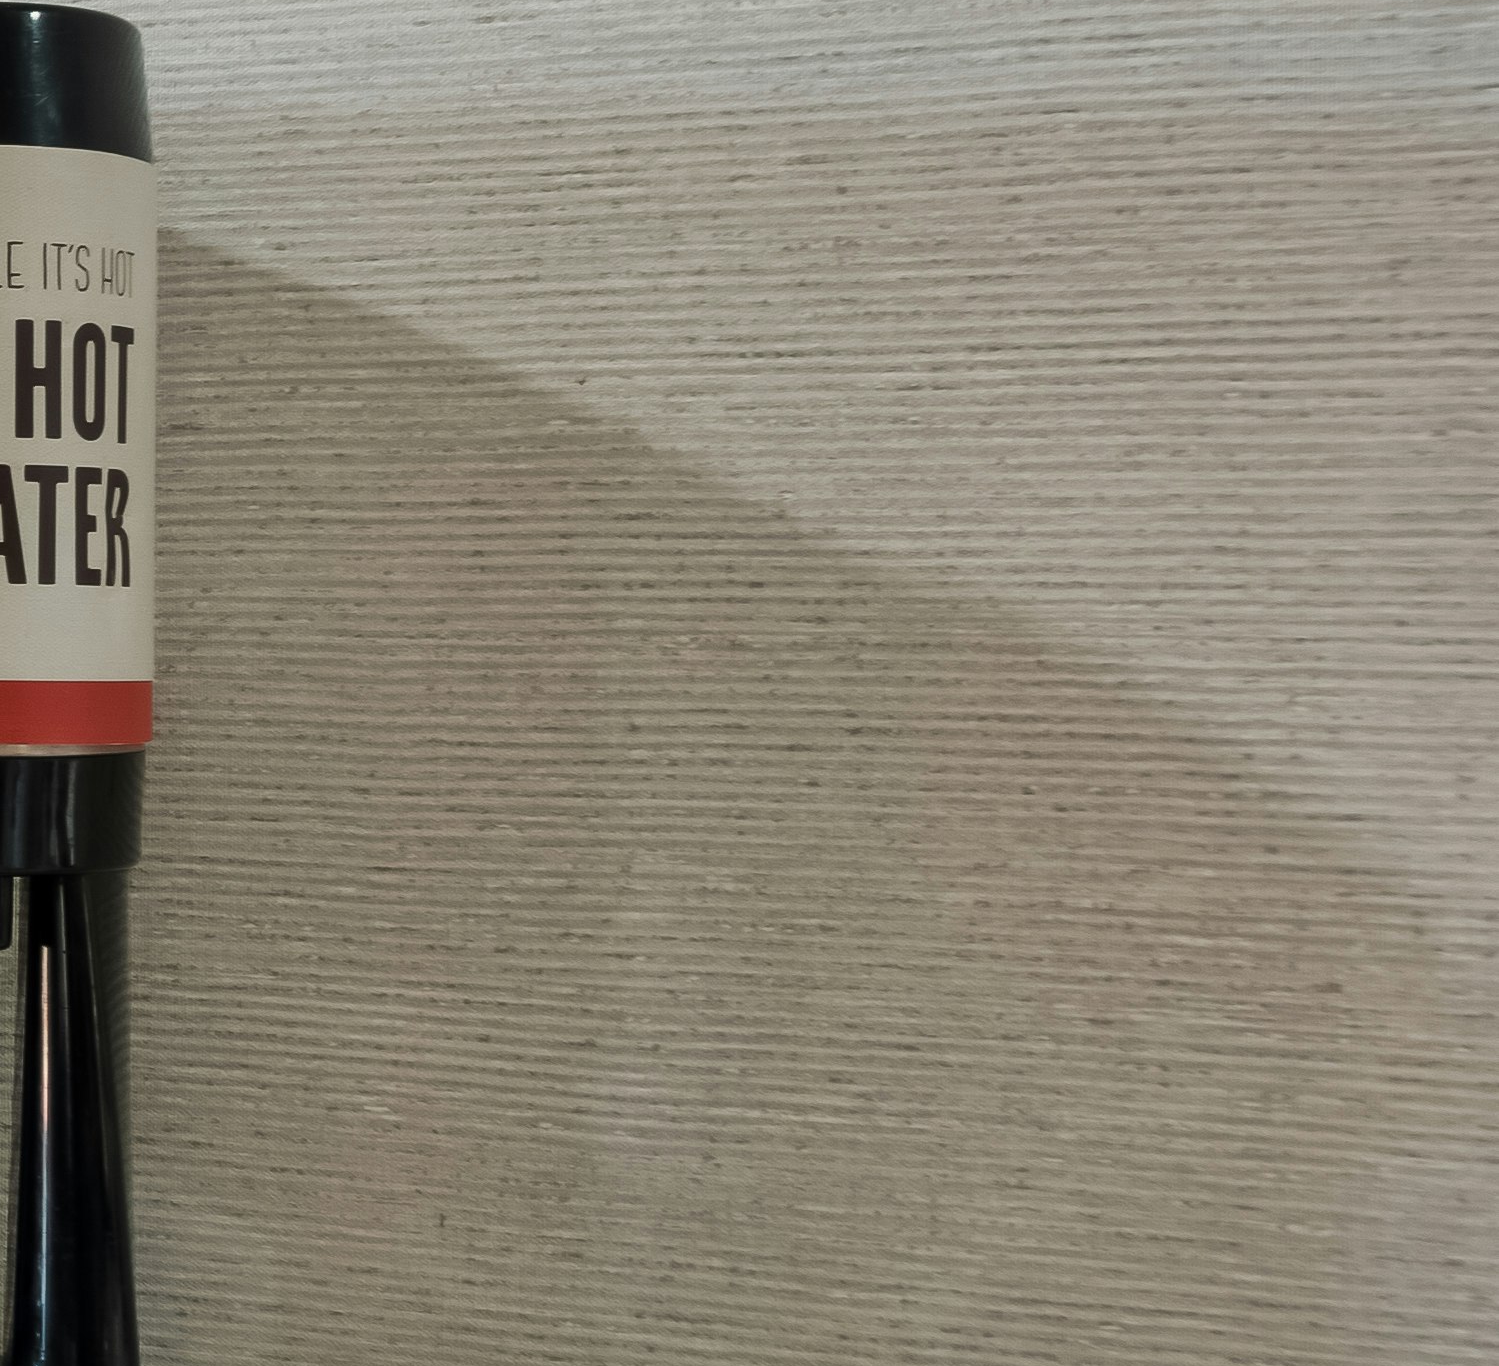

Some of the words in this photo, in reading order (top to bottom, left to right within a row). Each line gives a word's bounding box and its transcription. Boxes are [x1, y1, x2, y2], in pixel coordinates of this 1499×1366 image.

[44, 242, 91, 292] IT'S
[101, 247, 136, 298] HOT
[14, 318, 135, 445] HOT
